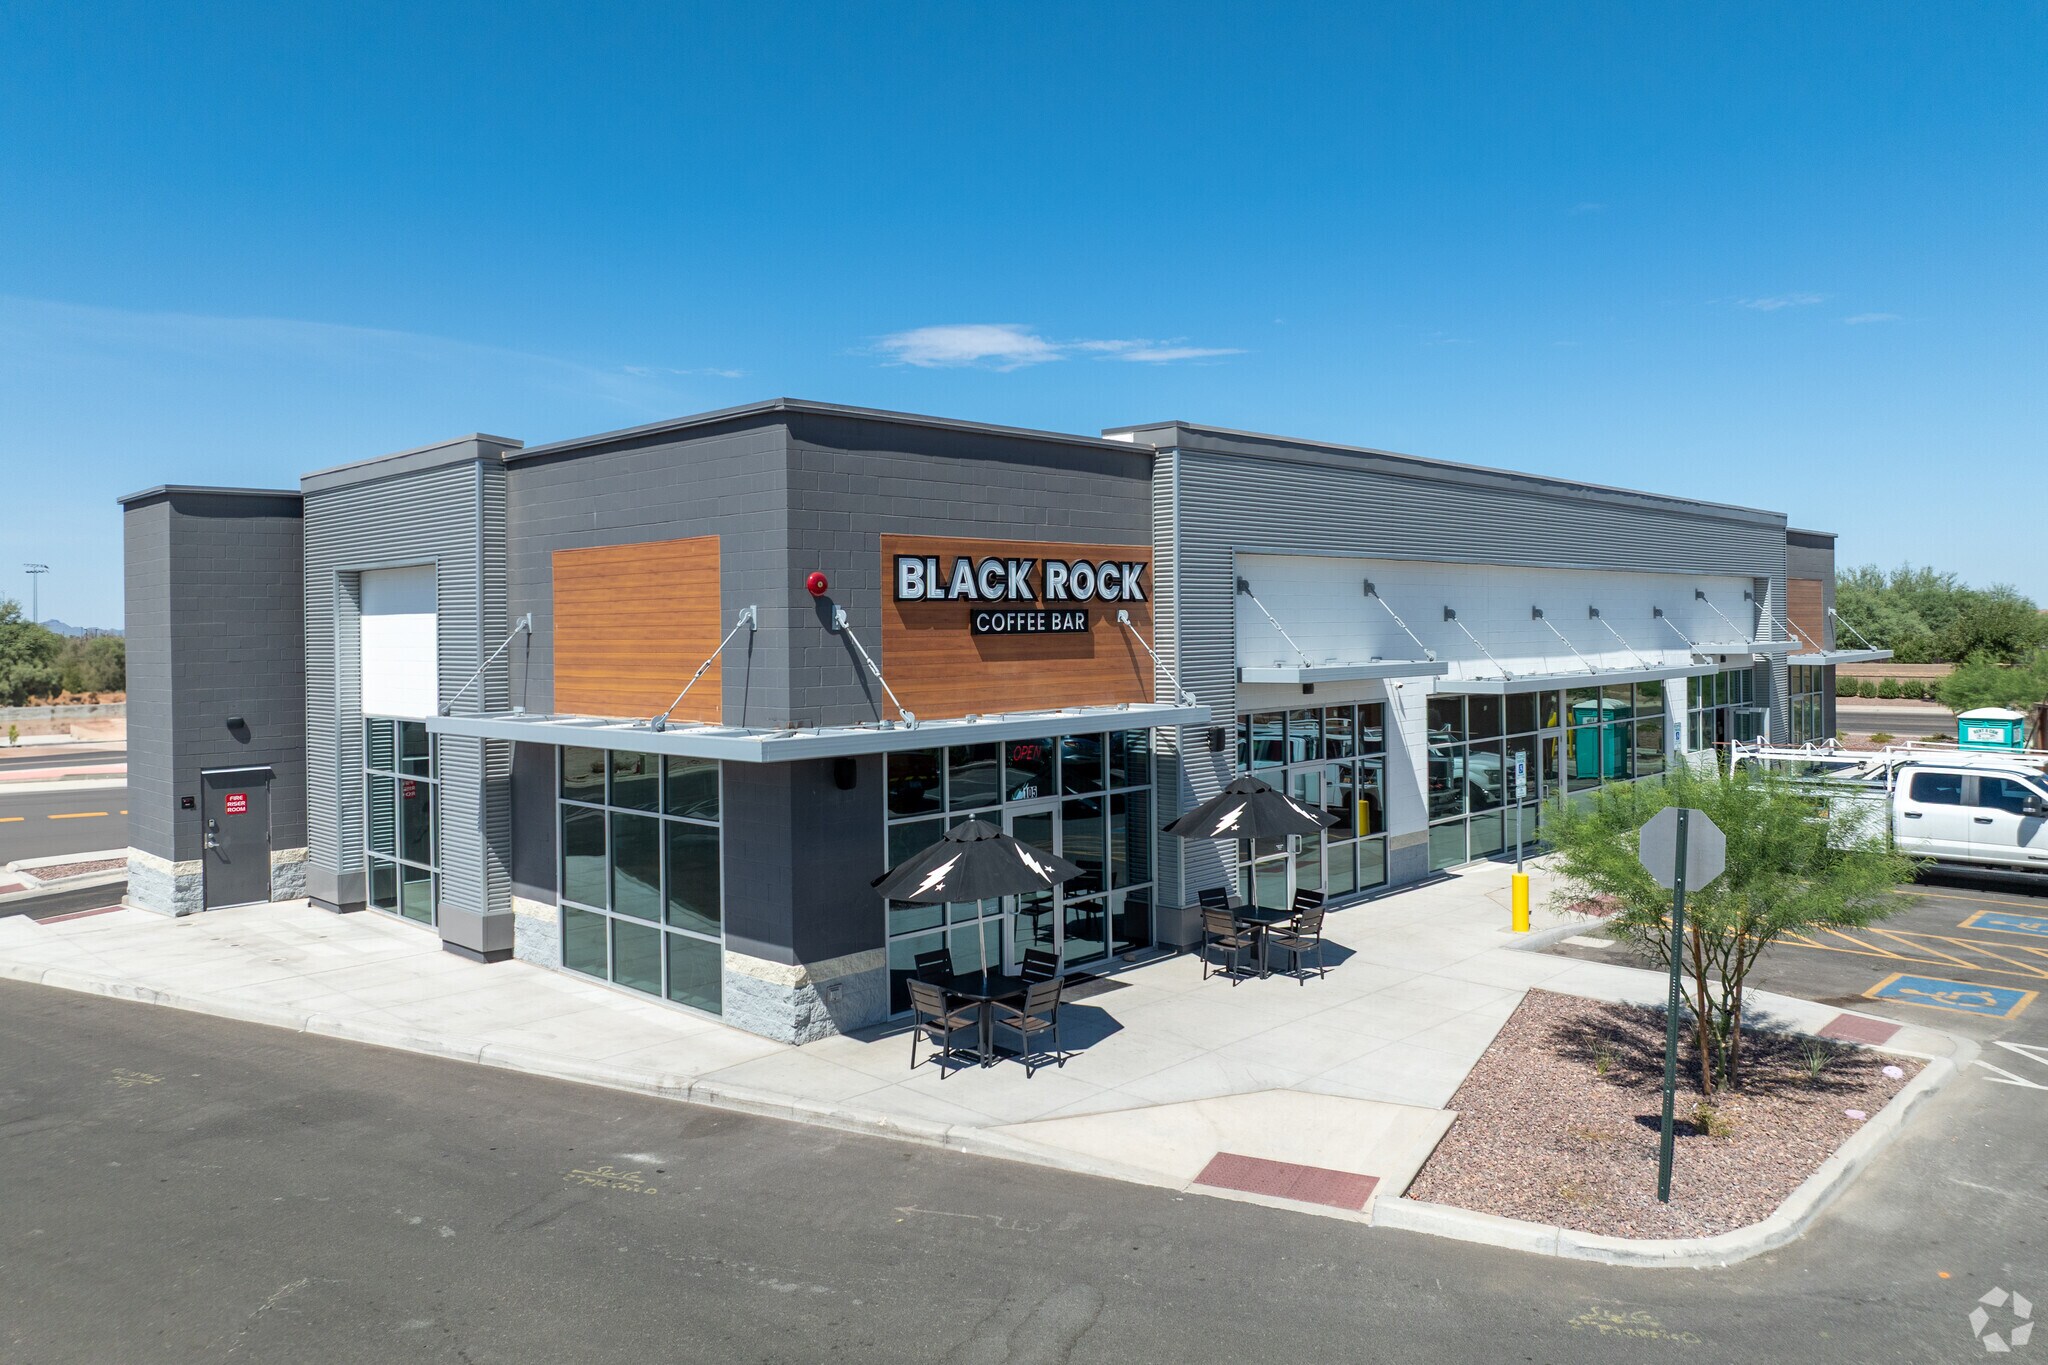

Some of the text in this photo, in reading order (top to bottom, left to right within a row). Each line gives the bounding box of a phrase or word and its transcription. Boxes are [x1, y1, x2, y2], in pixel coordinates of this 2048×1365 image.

[895, 555, 1146, 602] BLACK ROCK
[976, 612, 1085, 632] COFFEE BAR
[1014, 745, 1040, 760] OPEN
[1023, 786, 1037, 798] 105
